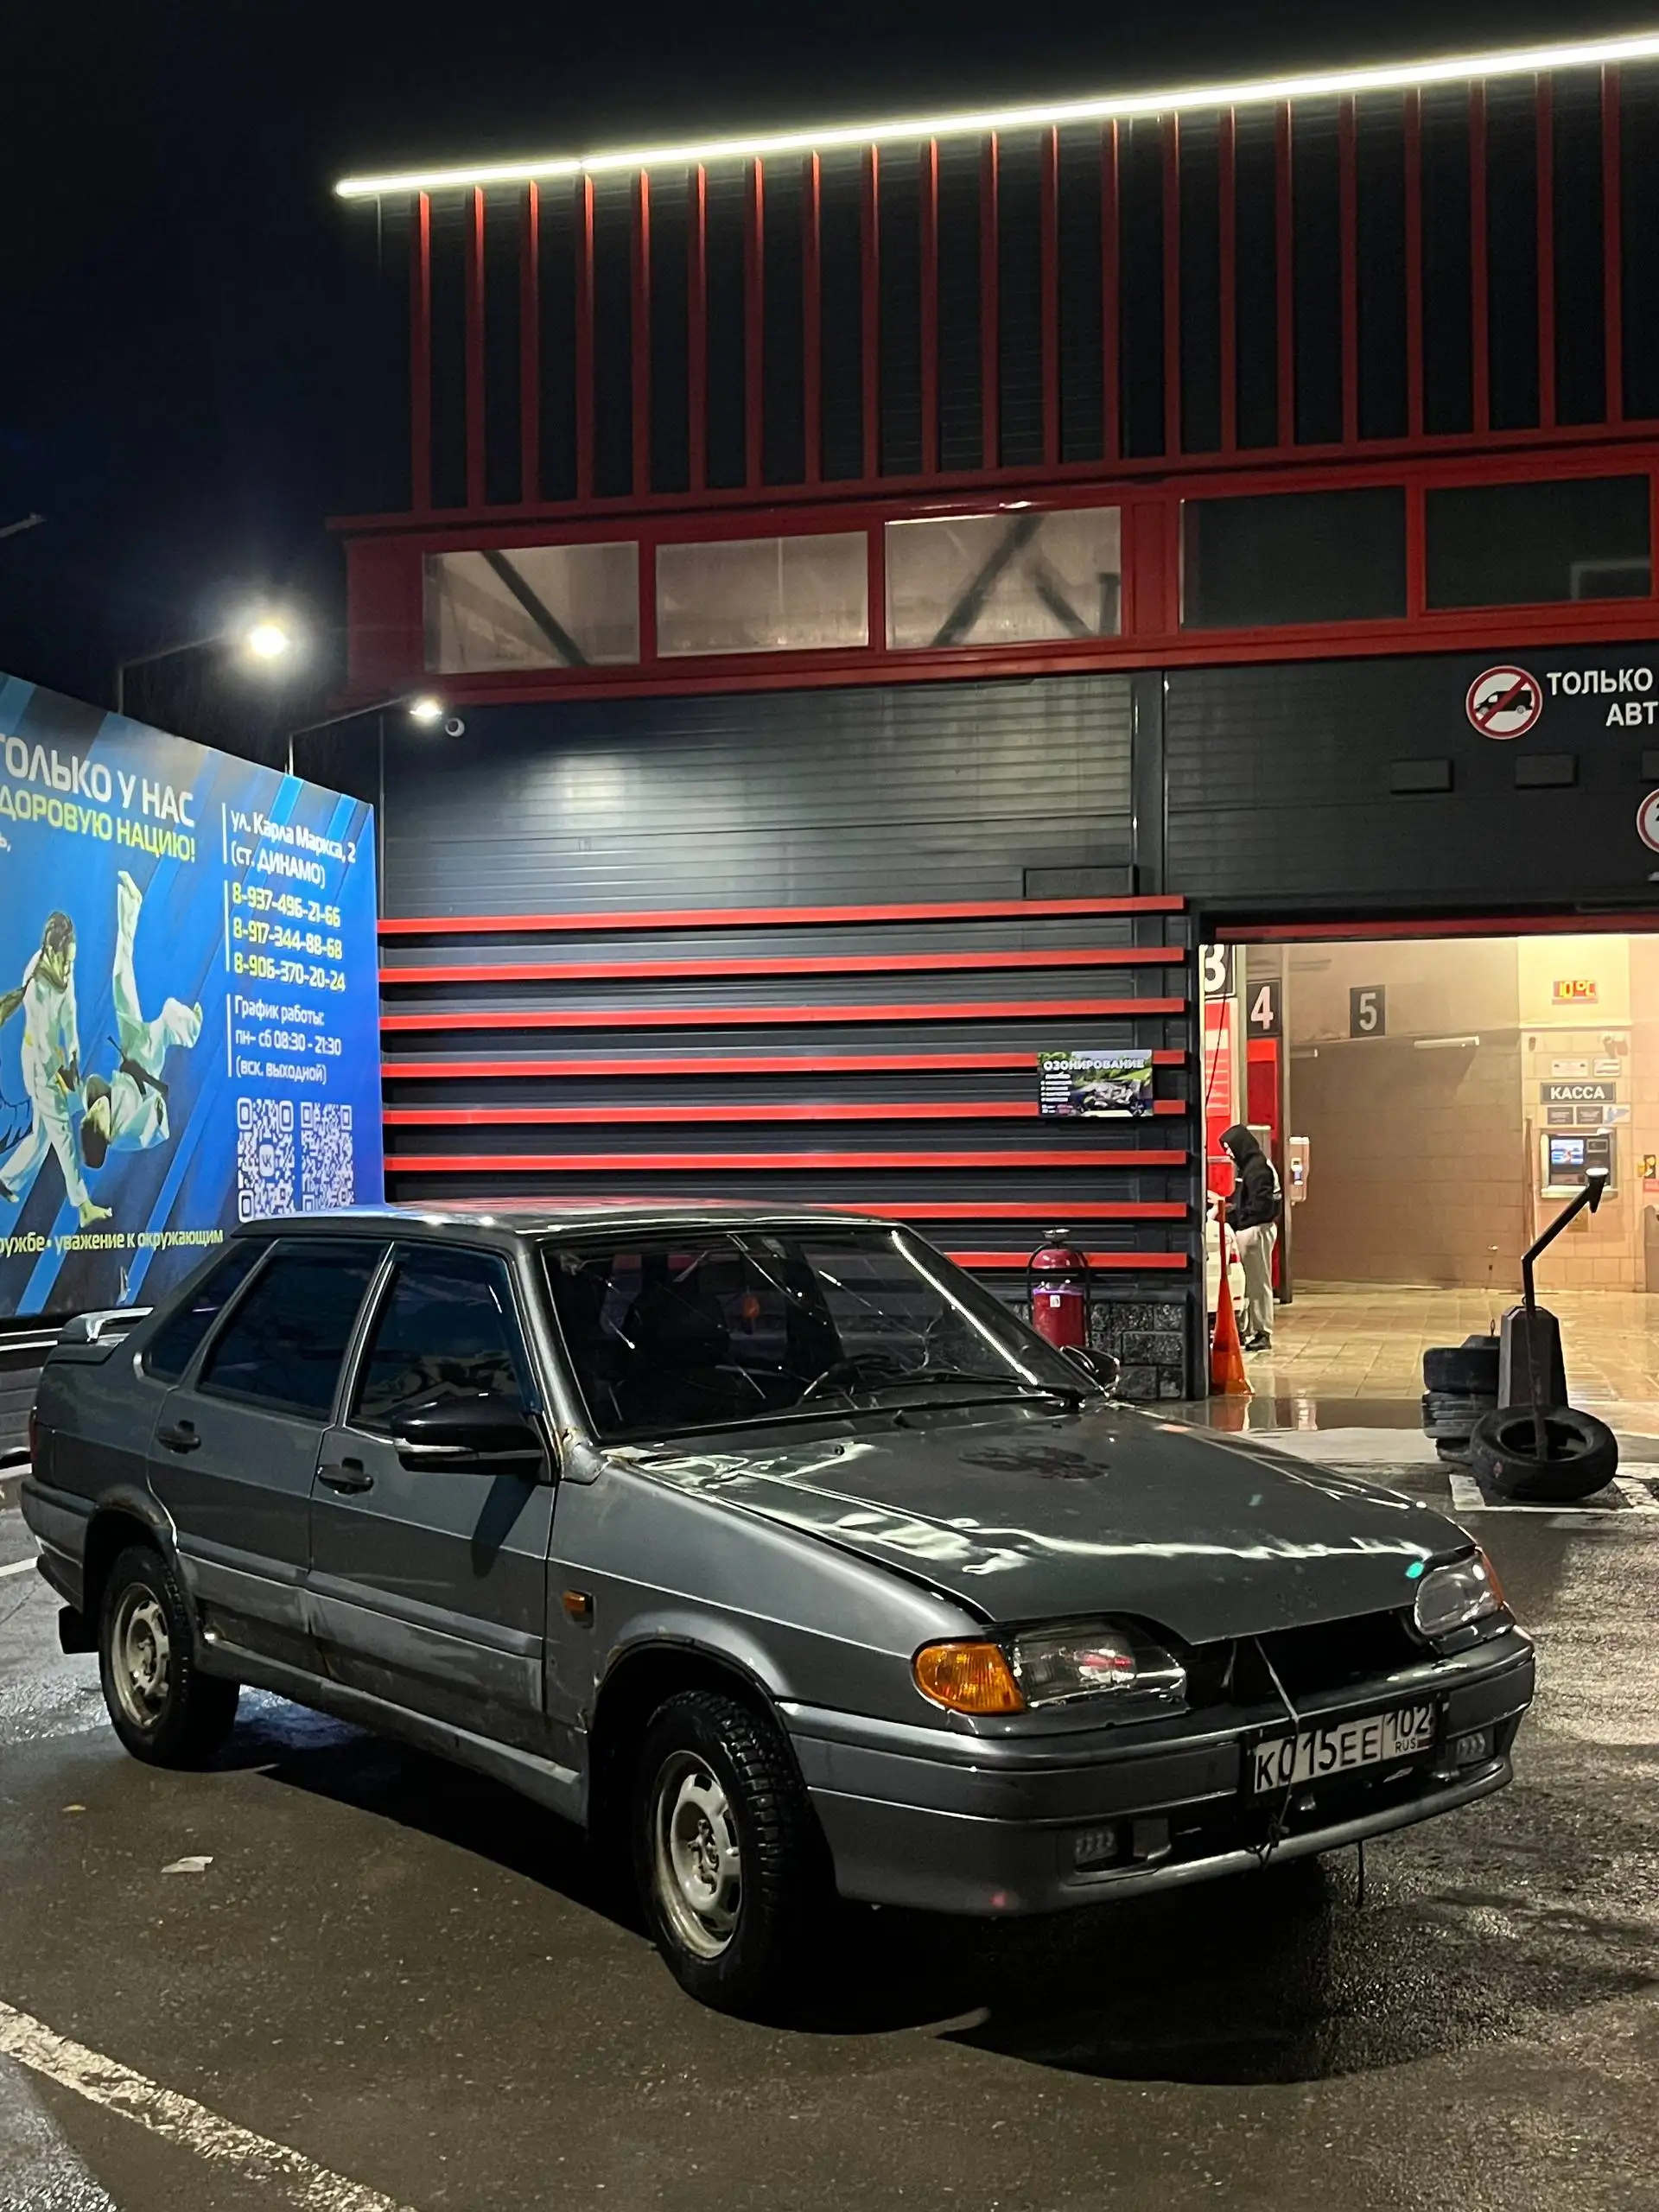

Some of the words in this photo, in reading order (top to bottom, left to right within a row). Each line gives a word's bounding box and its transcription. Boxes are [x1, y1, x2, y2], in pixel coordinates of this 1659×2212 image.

[1547, 668, 1653, 696] ТОЛЬКО
[1605, 701, 1659, 727] АВТ
[118, 770, 137, 809] У
[142, 779, 194, 828] НАС
[117, 817, 195, 863] НАЦИЮ!
[231, 810, 251, 833] ул.
[253, 812, 294, 845] Карла
[296, 825, 346, 863] Маркса,
[347, 842, 357, 864] 2
[231, 840, 255, 867] (ст.
[257, 848, 326, 890] ДИНАМО)
[232, 882, 341, 928] 8-937-496-21-66
[234, 951, 346, 992] 8-906-370-20-24
[234, 995, 279, 1021] График
[1250, 985, 1274, 1031] 4
[1359, 993, 1377, 1031] 5
[274, 1030, 306, 1052] 08:30
[236, 1055, 264, 1078] (вск.
[266, 1062, 327, 1085] выходной)
[1043, 1058, 1144, 1071] ОЗОНИРОВАНИЕ
[1550, 1086, 1605, 1100] КАССА
[54, 1232, 124, 1255] уважение
[127, 1232, 135, 1248] к
[137, 1230, 224, 1250] окружающим
[1395, 1738, 1416, 1754] RUS
